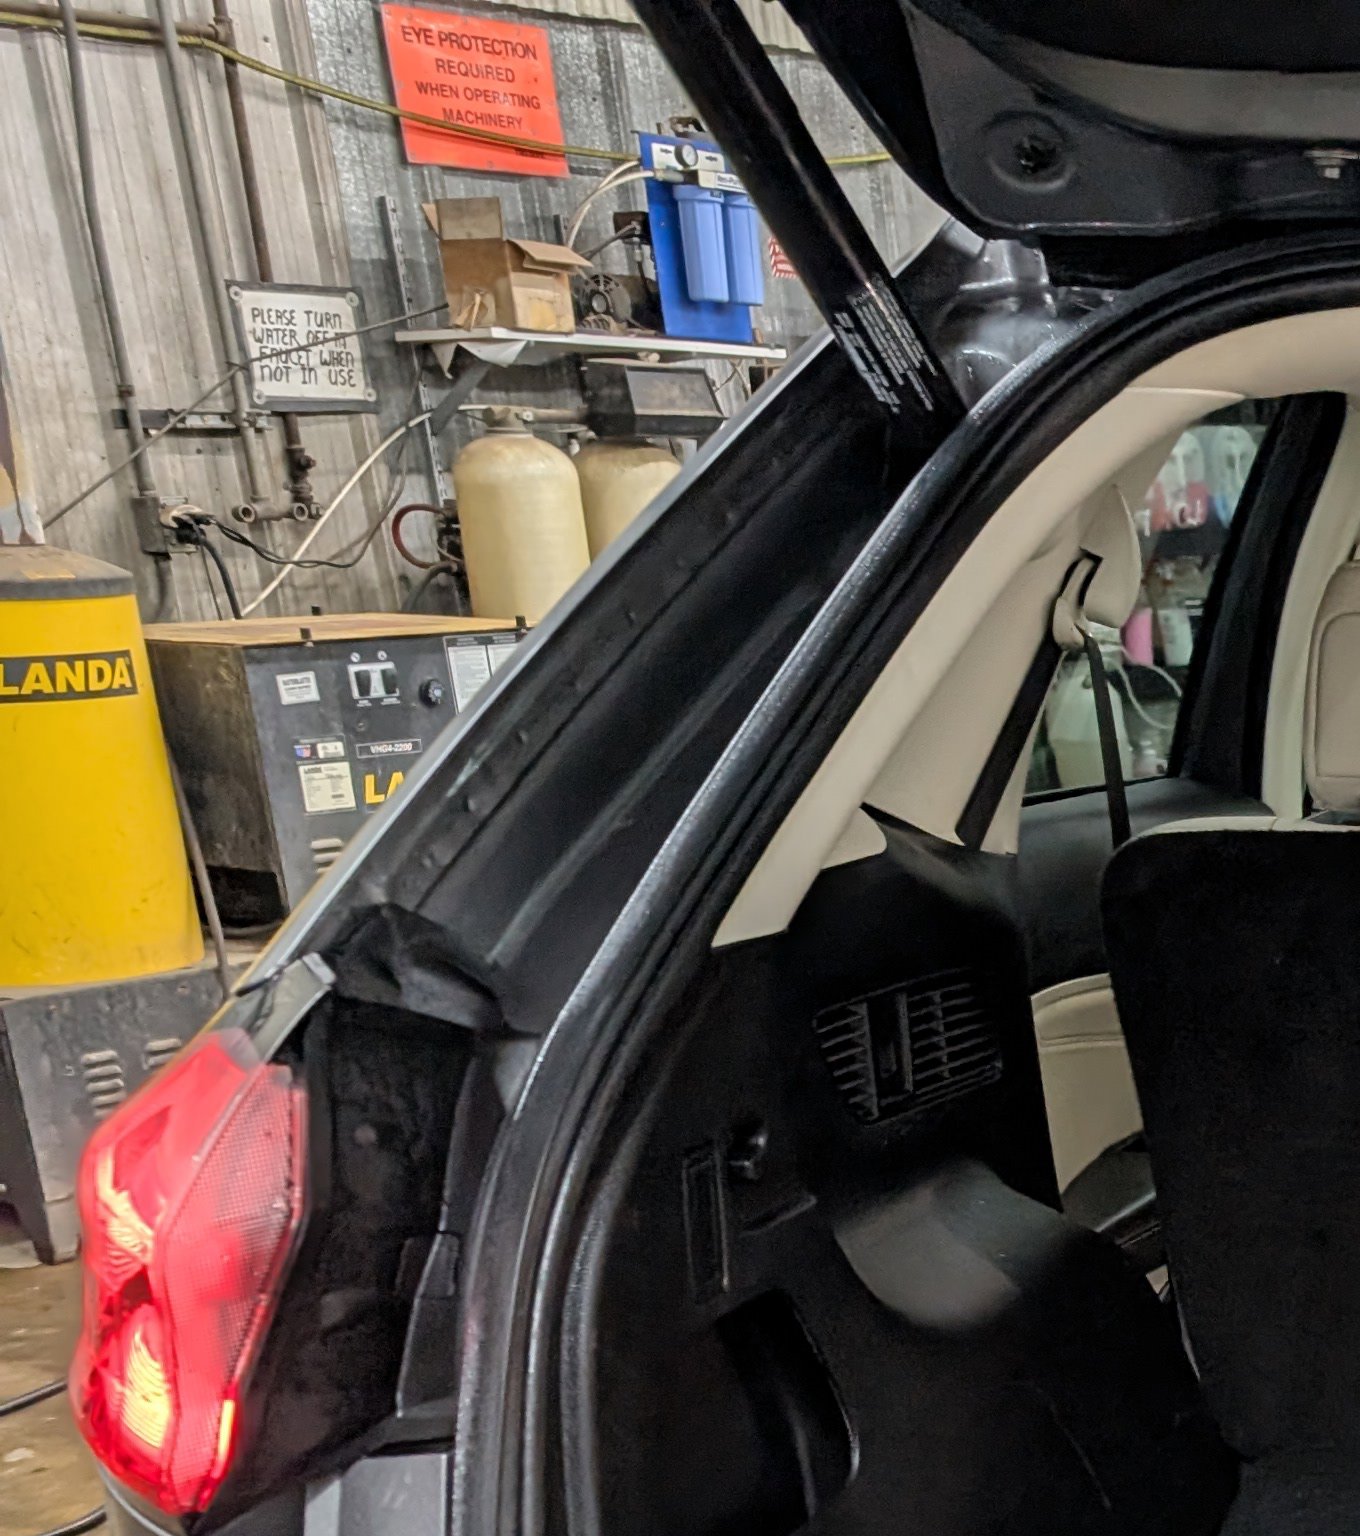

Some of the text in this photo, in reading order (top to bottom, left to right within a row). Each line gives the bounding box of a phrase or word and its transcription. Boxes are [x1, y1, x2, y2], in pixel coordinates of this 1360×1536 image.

[400, 24, 538, 61] EYE PROTECTION
[434, 58, 516, 83] REQUIRED
[415, 80, 541, 110] WHEN OPERATING
[442, 107, 524, 130] MACHINERY
[251, 307, 297, 327] PLEASE
[252, 327, 301, 346] WATER
[259, 345, 313, 367] FAUCET
[328, 369, 357, 387] USE
[0, 657, 132, 695] LANDA
[364, 771, 404, 804] LA
